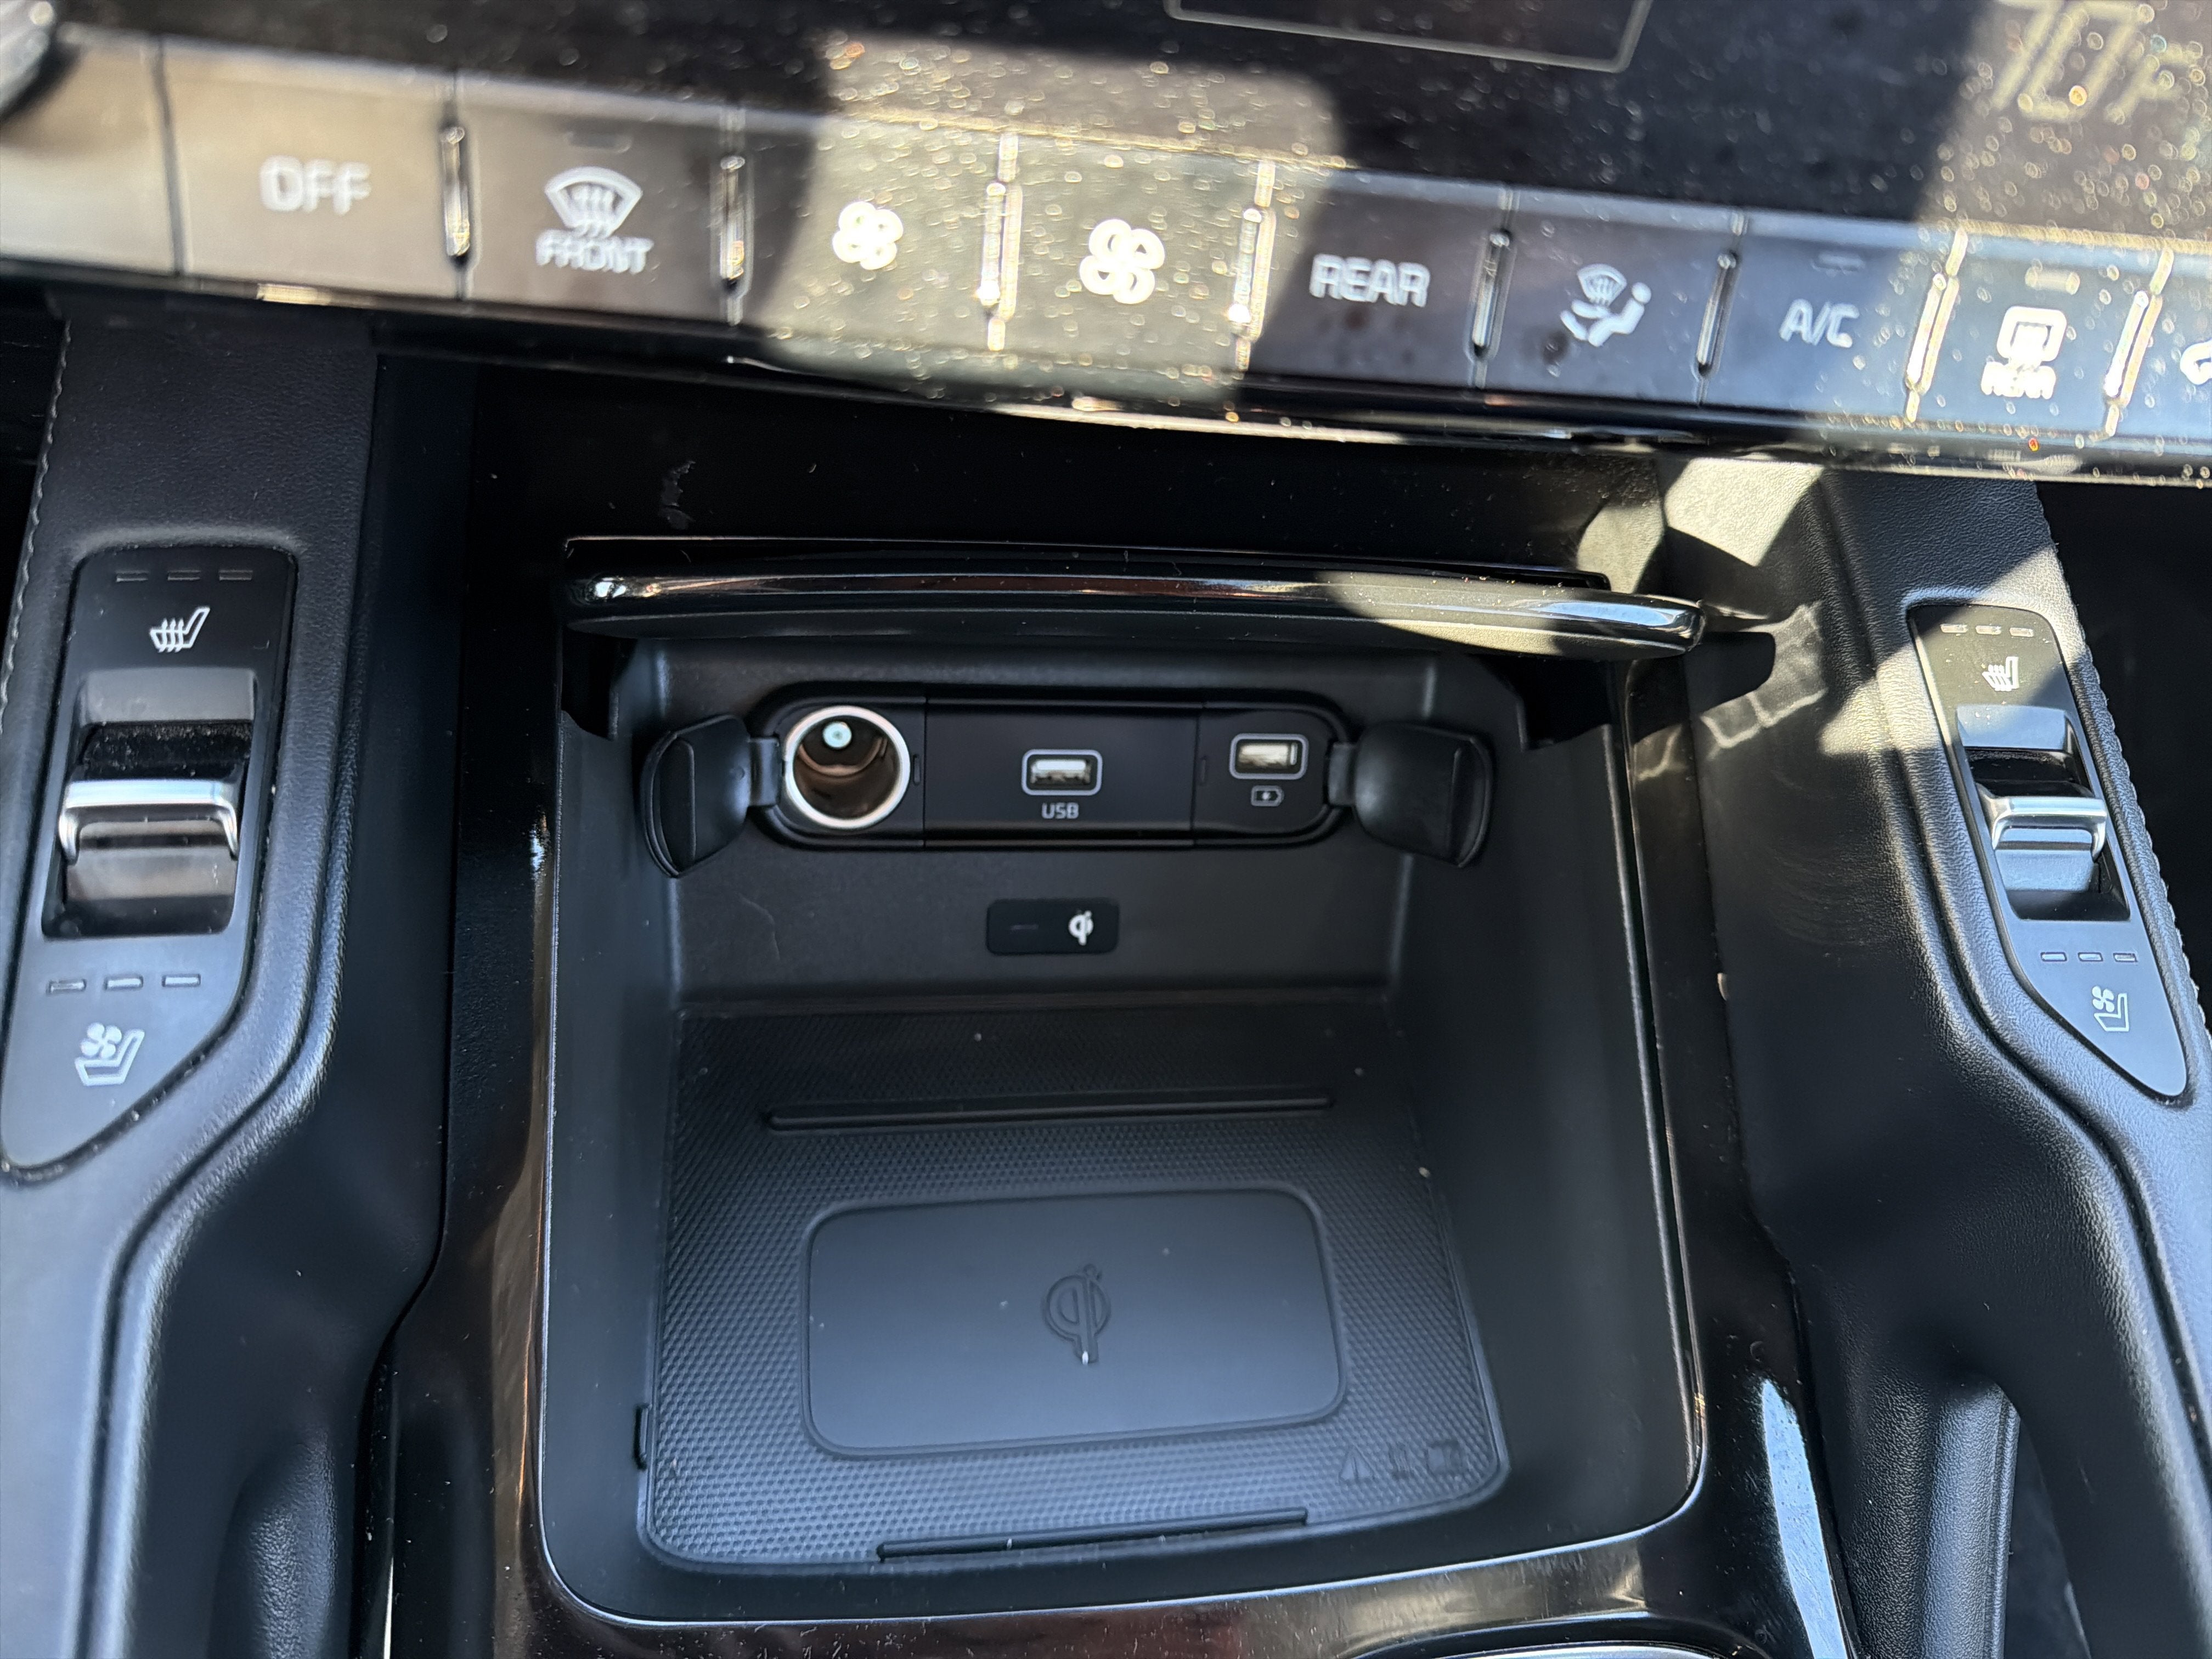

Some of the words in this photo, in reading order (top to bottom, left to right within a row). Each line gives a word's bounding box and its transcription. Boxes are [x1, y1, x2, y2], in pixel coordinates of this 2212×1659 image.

[259, 155, 370, 214] OFF
[536, 228, 653, 274] FRONT
[1310, 253, 1431, 307] REAR
[1780, 298, 1860, 349] A/C
[1042, 802, 1079, 819] USB
